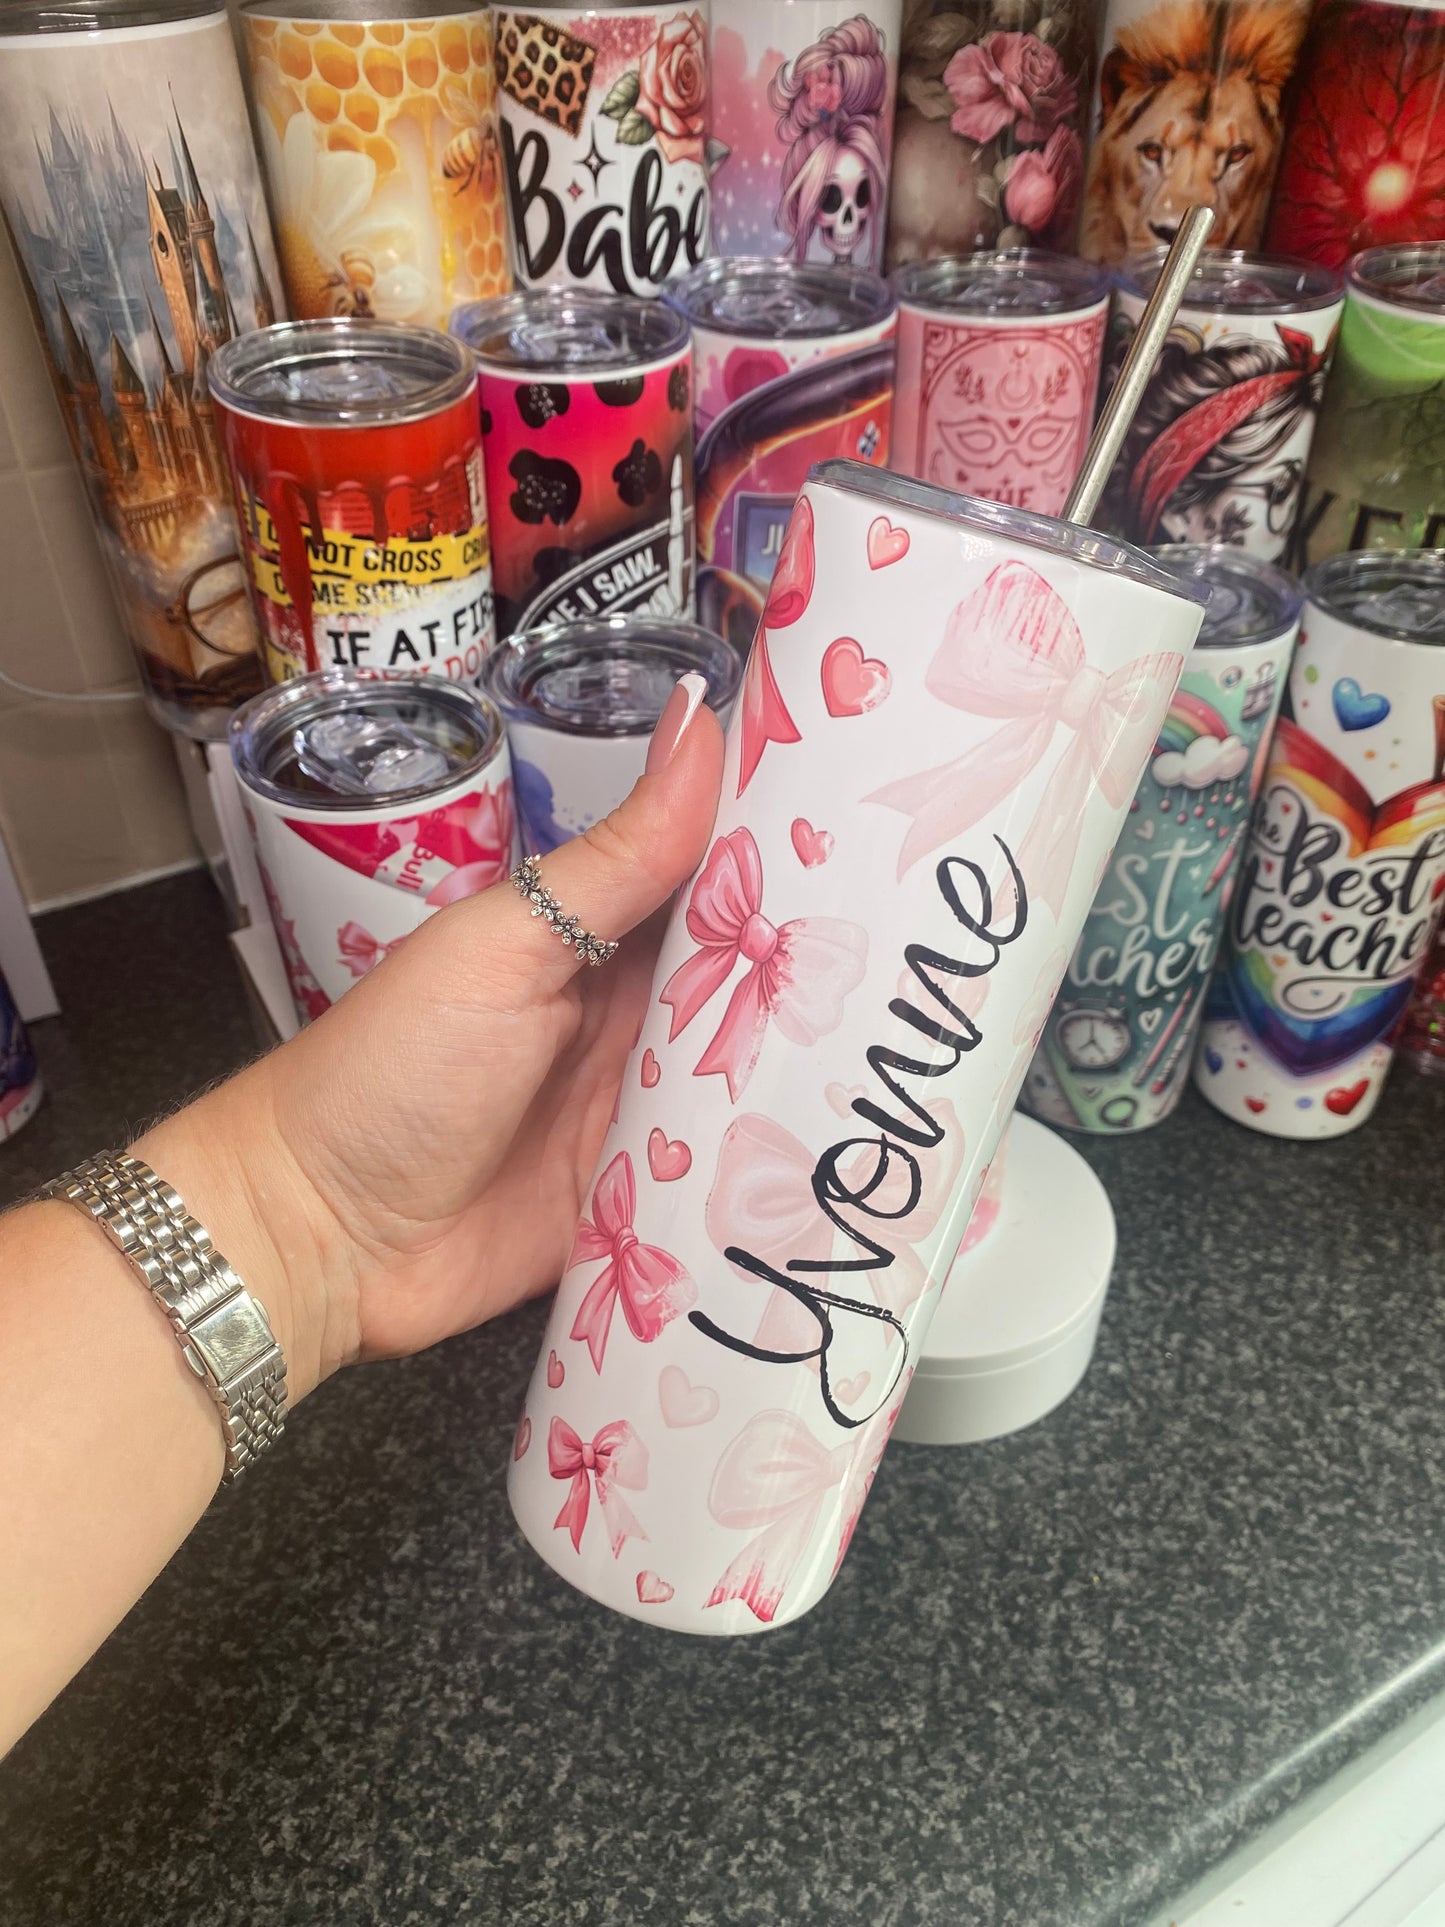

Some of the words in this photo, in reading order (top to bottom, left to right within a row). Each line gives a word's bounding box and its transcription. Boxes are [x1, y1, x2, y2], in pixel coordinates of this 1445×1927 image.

[363, 548, 443, 573] CROSS
[593, 547, 662, 602] SAW.
[326, 630, 370, 666] IF
[389, 621, 441, 666] AT
[395, 845, 436, 891] Bull
[1269, 786, 1445, 916] Best
[1091, 838, 1213, 940] st
[688, 833, 1028, 1430] Yvonne
